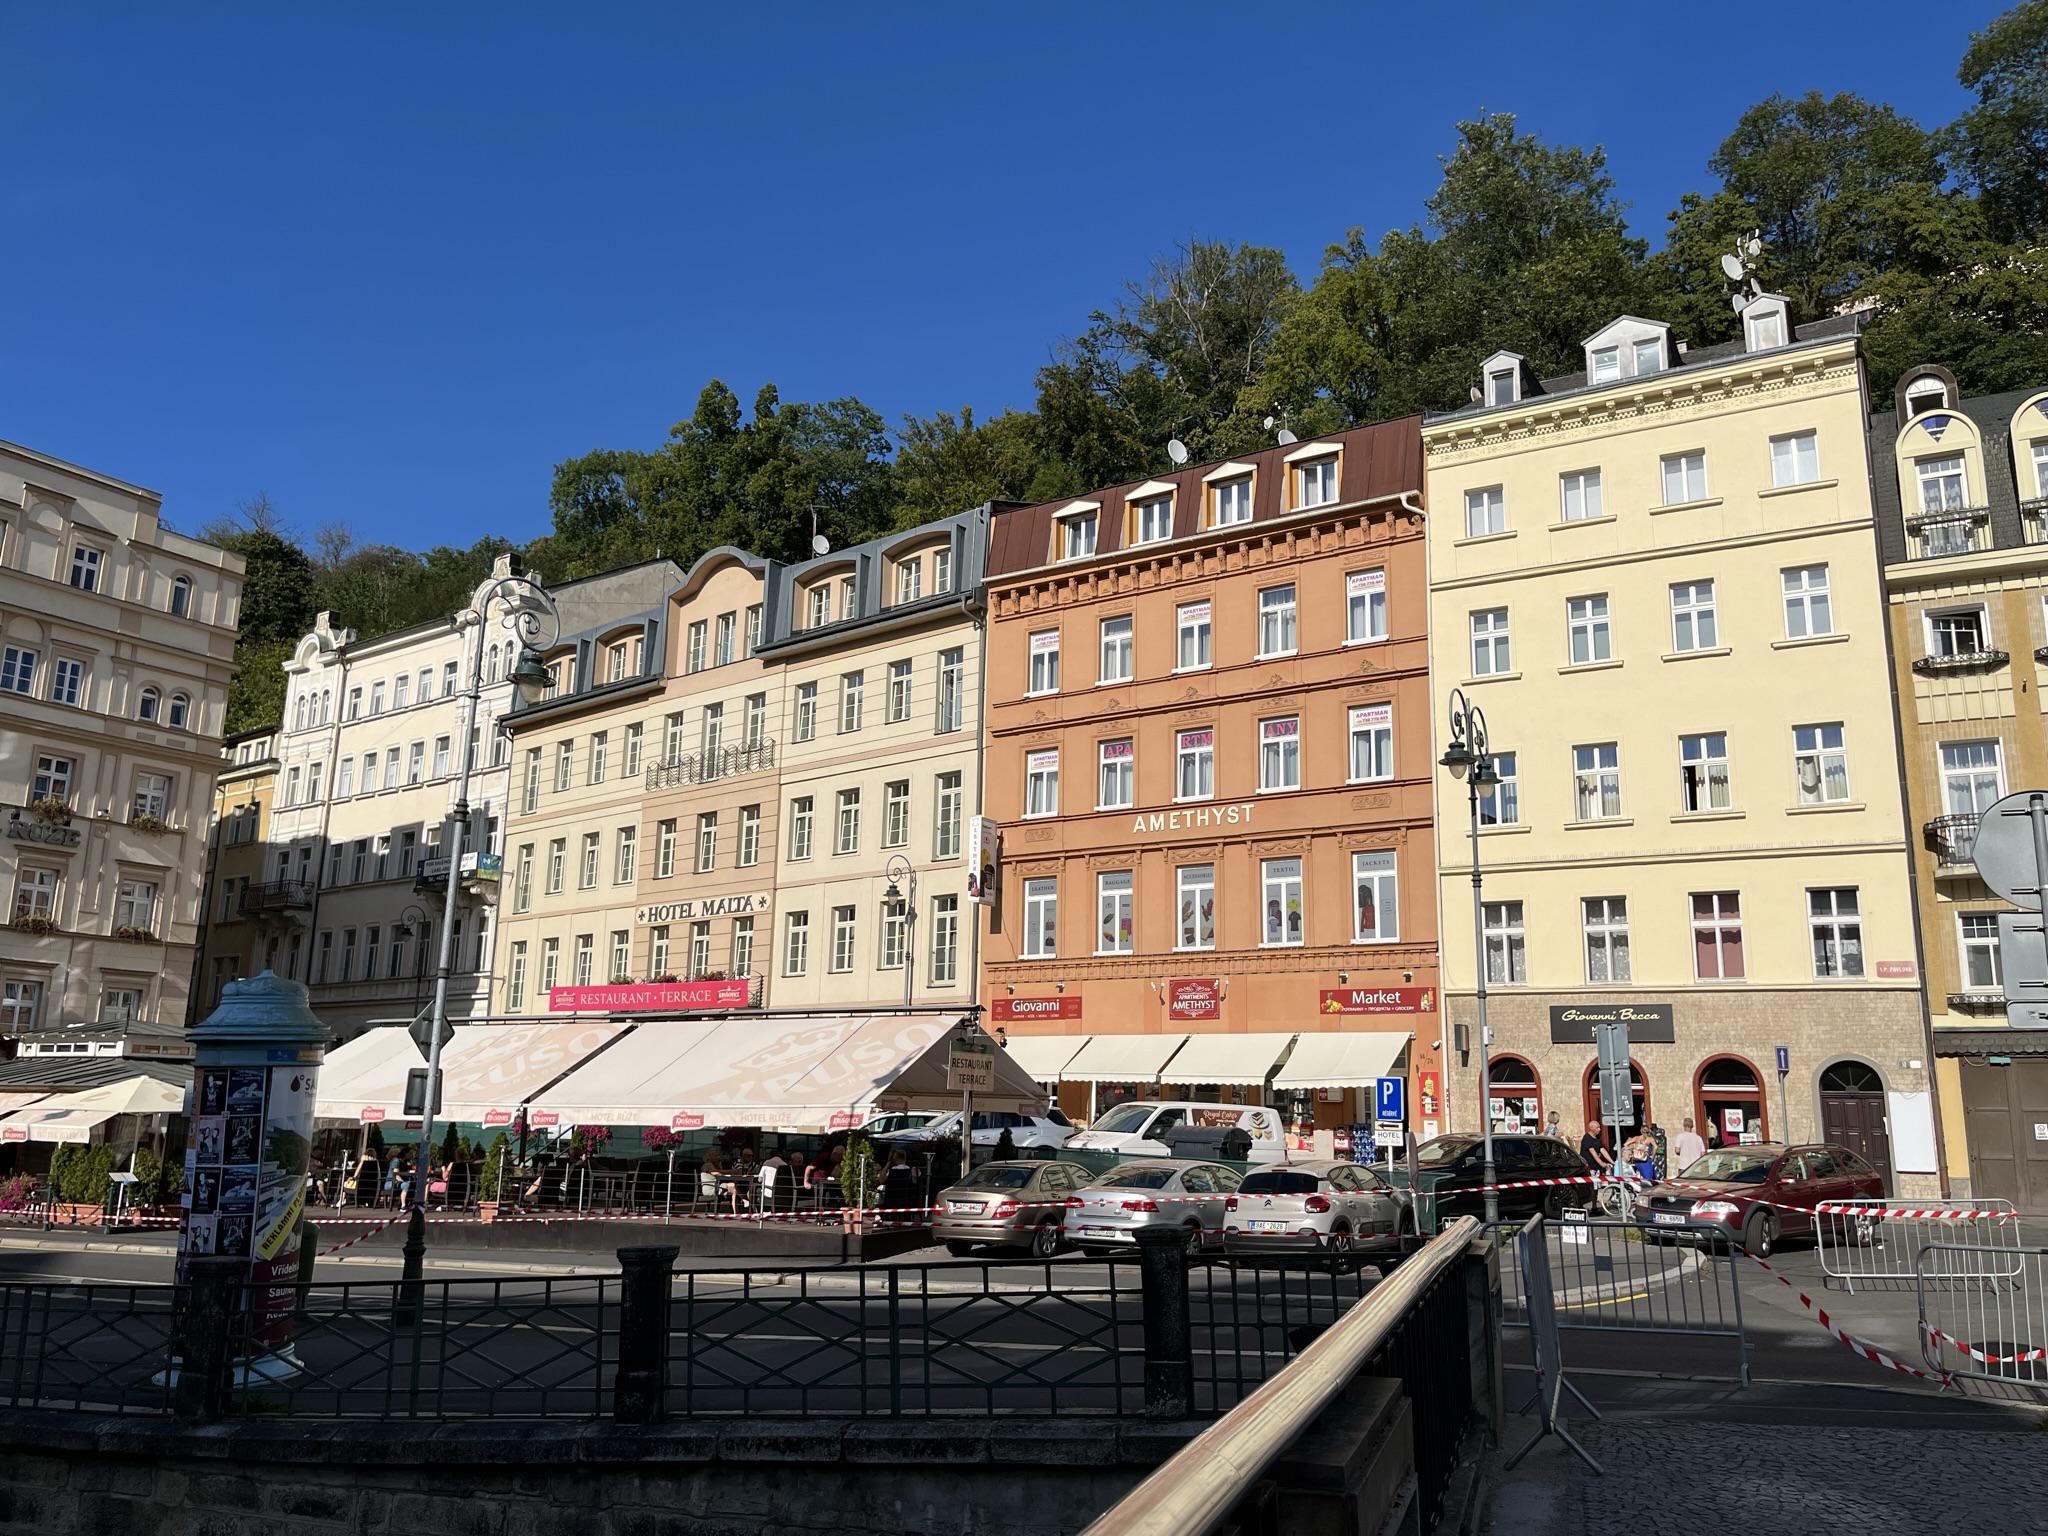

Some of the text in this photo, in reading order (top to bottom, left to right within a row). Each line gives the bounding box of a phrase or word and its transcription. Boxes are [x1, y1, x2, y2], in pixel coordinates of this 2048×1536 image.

[1133, 803, 1256, 834] AMETHYST
[647, 894, 754, 923] HOTEL MALTA
[580, 991, 652, 1005] RESTAURANT
[660, 989, 712, 1004] TERRACE
[1352, 990, 1401, 1005] Market
[1012, 999, 1060, 1013] Giovanni
[1172, 1000, 1216, 1009] AMETHYST
[1561, 1008, 1661, 1021] Giovanni Becca
[951, 1057, 993, 1071] RESTAURANT
[958, 1073, 987, 1086] TERRACE
[1383, 1081, 1394, 1105] P
[1203, 1109, 1221, 1120] Royal
[1377, 1131, 1401, 1139] HOTEL
